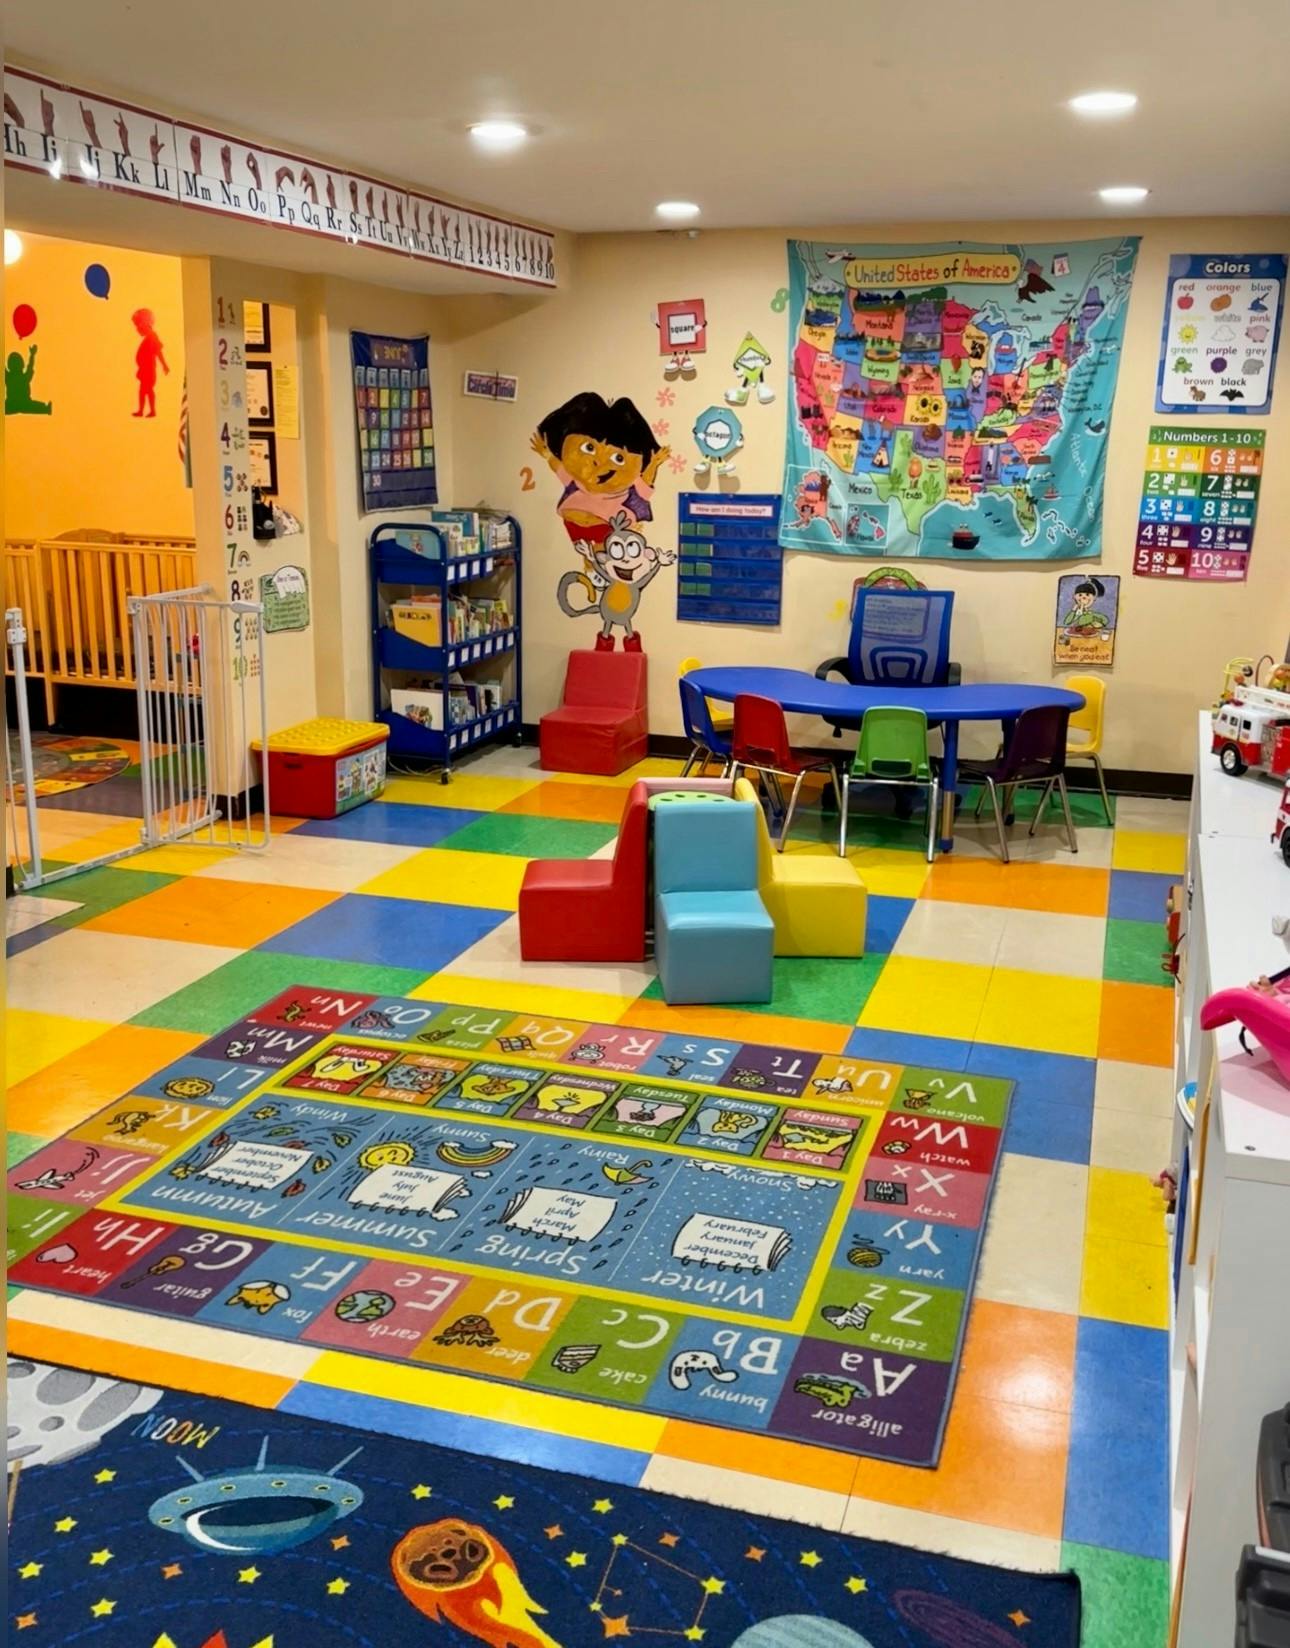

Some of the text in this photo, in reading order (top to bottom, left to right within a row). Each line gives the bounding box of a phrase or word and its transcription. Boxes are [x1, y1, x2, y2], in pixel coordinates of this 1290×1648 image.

[40, 132, 554, 279] Ii Kk Ll Mm Nn Oo Pp Qq Rr Ss Tt Uu 3 5 6 8 9 10
[854, 259, 1010, 283] United States of America
[1205, 262, 1251, 273] Colors
[1178, 283, 1273, 294] red orange blue
[217, 296, 225, 324] 1
[1249, 314, 1271, 324] pink
[670, 325, 695, 334] square
[865, 319, 894, 331] Montana
[219, 338, 228, 366] 2
[1170, 347, 1267, 358] green purple grey
[1184, 378, 1247, 386] brown black
[221, 422, 230, 448] 4
[1163, 431, 1218, 443] Numbers
[1152, 448, 1222, 465] 1 6
[224, 465, 233, 492] 5
[520, 466, 536, 492] 2
[1148, 473, 1219, 491] 2 7
[848, 482, 873, 495] Mexico
[902, 488, 923, 500] Texas
[225, 504, 234, 530] 6
[1145, 499, 1215, 517] 3 8
[1141, 525, 1212, 543] 4 9
[227, 543, 237, 568] 7
[1138, 549, 1214, 568] 5 10
[310, 995, 363, 1017] Nn
[384, 1004, 431, 1025] Oo
[299, 1020, 333, 1031] newt
[358, 1028, 407, 1041] octopus
[248, 1027, 314, 1052] Mm
[446, 1038, 483, 1050] pizza
[257, 1054, 287, 1064] milk
[331, 1045, 394, 1061] Saturday
[418, 1055, 458, 1068] Friday
[477, 1063, 541, 1080] Thursday
[599, 1060, 638, 1072] robot
[300, 1080, 342, 1092] Day 7
[549, 1074, 618, 1091] Wednesday
[687, 1073, 717, 1083] seal
[374, 1089, 417, 1103] Day 6
[633, 1085, 690, 1104] Tuesday
[776, 1084, 799, 1095] tea
[207, 1094, 232, 1106] lion
[454, 1100, 494, 1114] Day 5
[715, 1098, 774, 1115] Monday
[825, 1093, 885, 1108] unicorn
[155, 1103, 213, 1131] Kk
[290, 1102, 348, 1123] Windy
[549, 1113, 573, 1126] Day
[793, 1110, 850, 1128] Sunday
[927, 1107, 985, 1123] volcano
[432, 1122, 493, 1144] Sunny
[614, 1123, 657, 1140] Day 3
[102, 1134, 170, 1153] kangaroo
[696, 1135, 740, 1152] Day 2
[238, 1145, 301, 1163] November
[577, 1145, 632, 1167] Rainy
[781, 1151, 824, 1165] Day 1
[919, 1151, 971, 1168] watch
[91, 1152, 150, 1184] Jj
[232, 1157, 284, 1171] October
[209, 1163, 281, 1184] September
[391, 1169, 440, 1184] August
[727, 1167, 794, 1192] Snowy
[74, 1189, 106, 1203] jet
[391, 1181, 418, 1195] July
[151, 1184, 278, 1219] Autumn
[378, 1190, 415, 1205] June
[556, 1194, 587, 1207] May
[544, 1207, 581, 1219] April
[913, 1204, 958, 1220] x-ray
[21, 1208, 71, 1238] Ii
[294, 1210, 438, 1250] Summer
[532, 1216, 578, 1234] March
[703, 1219, 769, 1241] February
[93, 1217, 166, 1256] Hh
[700, 1231, 759, 1250] January
[179, 1232, 254, 1271] Gg
[474, 1234, 588, 1276] Spring
[683, 1244, 760, 1265] December
[61, 1264, 113, 1284] heart
[899, 1264, 946, 1281] yarn
[152, 1282, 213, 1300] guitar
[640, 1269, 764, 1310] Winter
[282, 1306, 314, 1325] fox
[482, 1287, 562, 1332] Dd
[366, 1322, 422, 1341] earth
[868, 1331, 928, 1352] zebra
[483, 1344, 532, 1364] deer
[712, 1329, 783, 1376] Bb
[598, 1366, 648, 1387] cake
[699, 1383, 769, 1414] bunny
[130, 1413, 221, 1449] MOON
[810, 1408, 903, 1439] alligator
